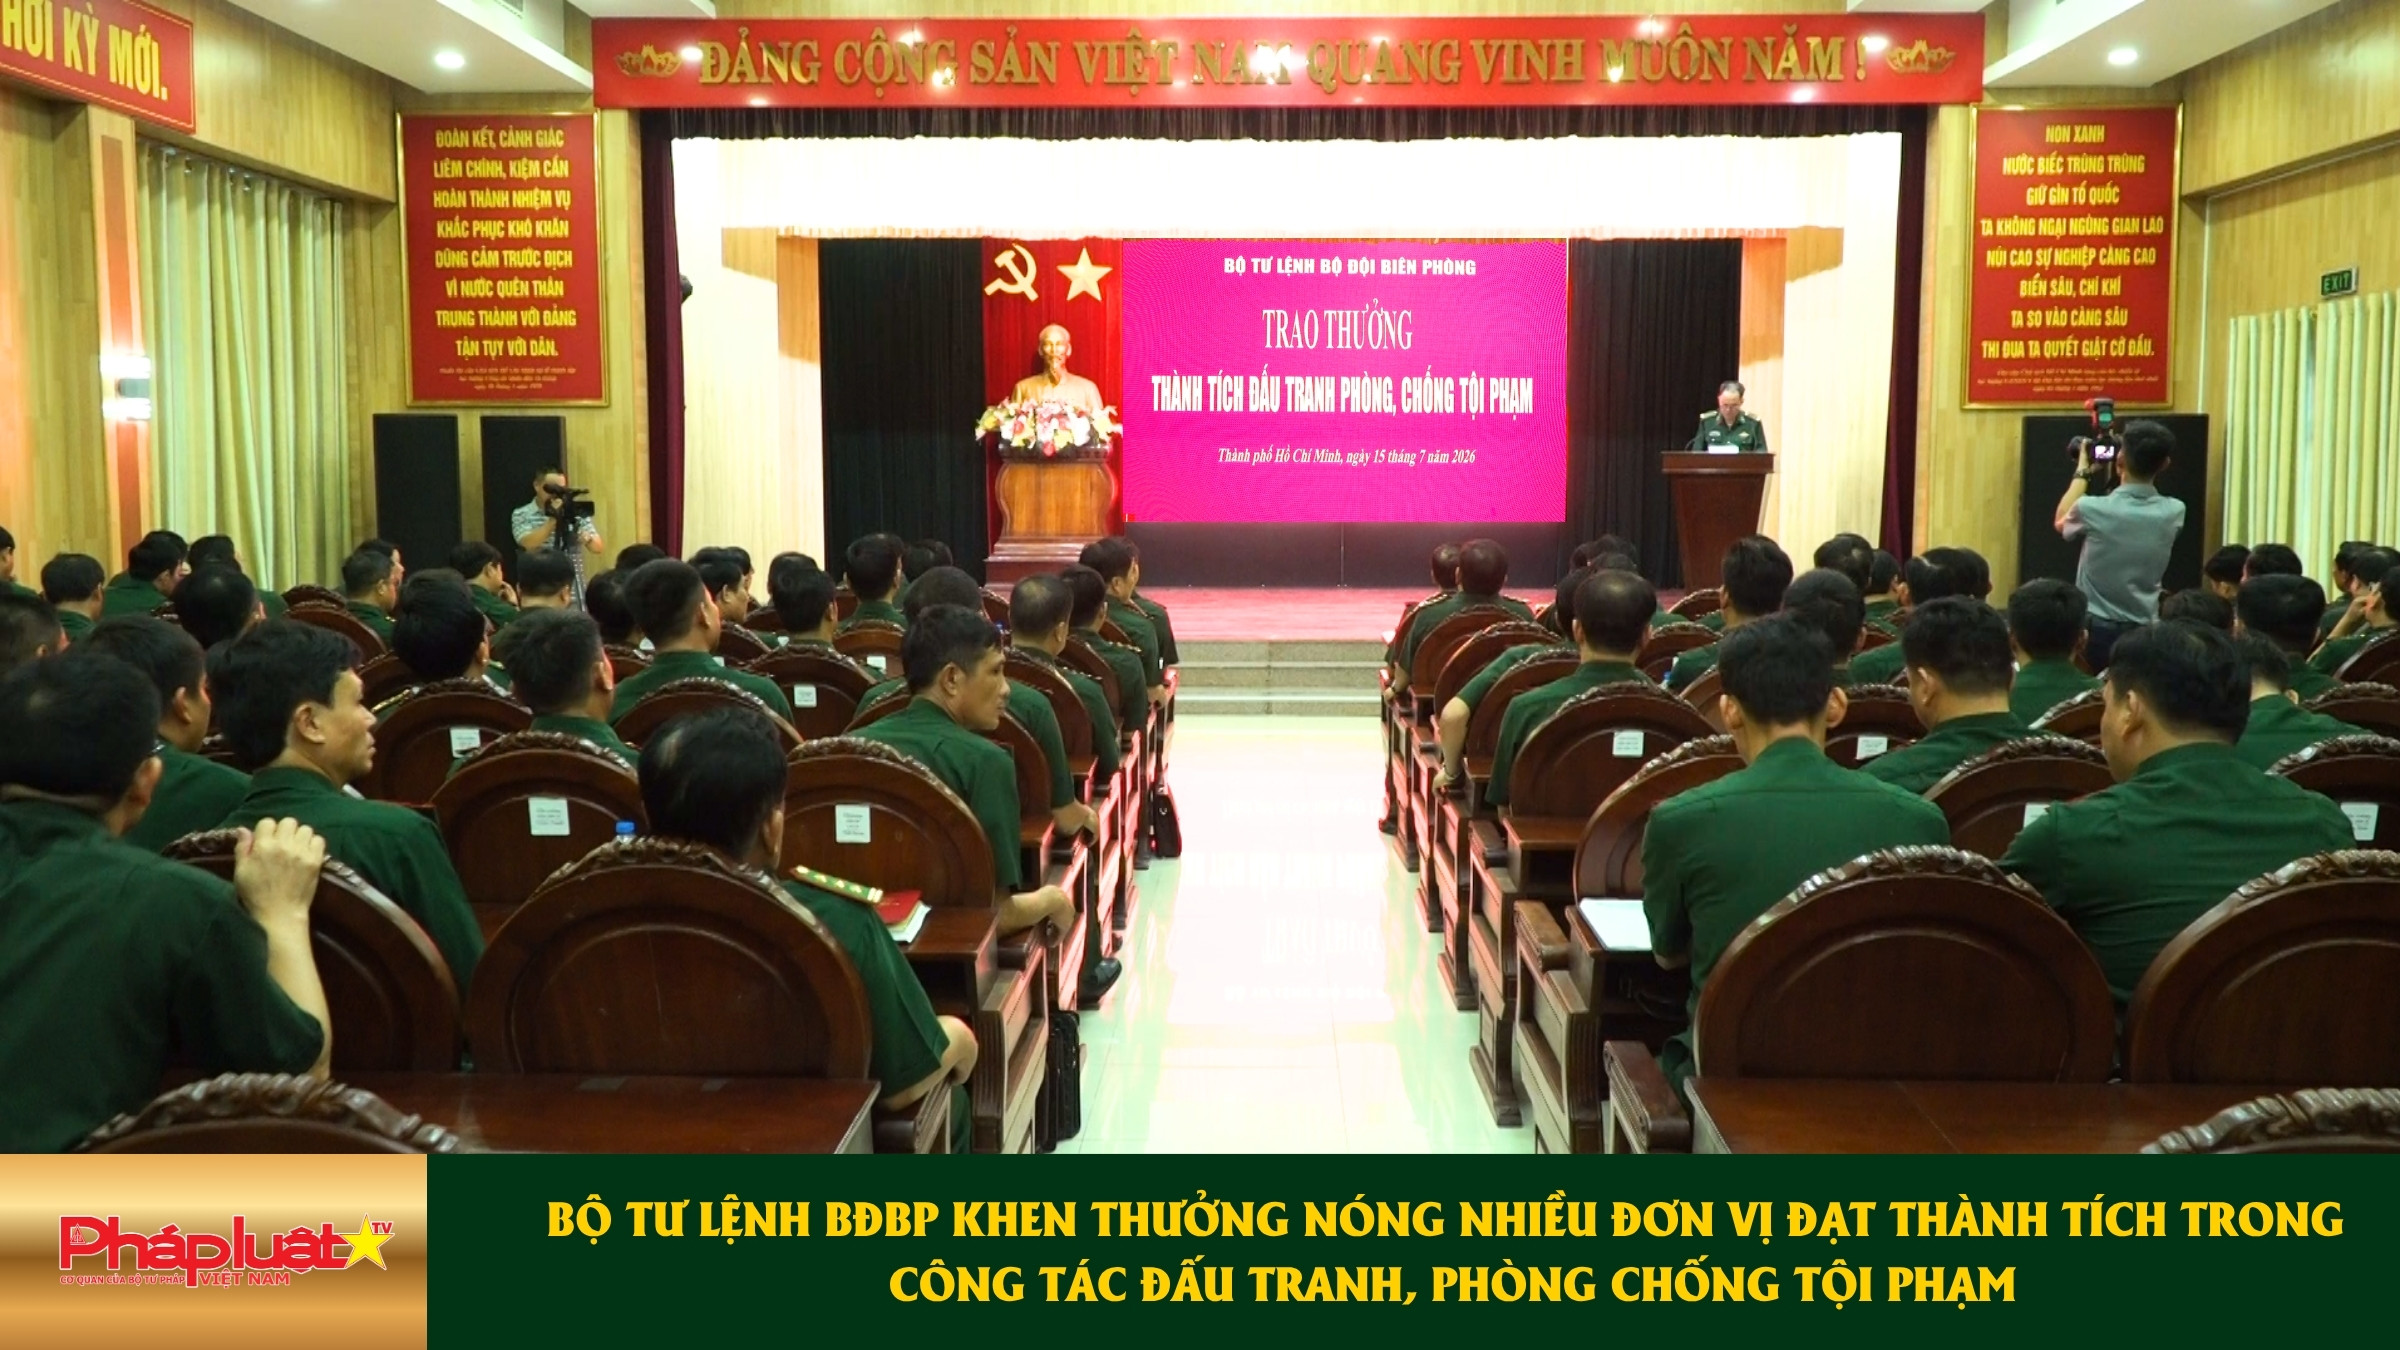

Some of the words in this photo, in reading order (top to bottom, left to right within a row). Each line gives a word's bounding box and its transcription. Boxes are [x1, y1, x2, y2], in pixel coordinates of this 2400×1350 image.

[63, 2, 99, 76] KỲ
[108, 24, 168, 101] MỚI.
[699, 27, 821, 86] ĐẢNG
[833, 27, 956, 97] CỘNG
[970, 26, 1060, 85] SẢN
[1073, 26, 1178, 96] VIỆT
[1191, 39, 1292, 85] NAM
[1306, 38, 1461, 94] QUANG
[1471, 38, 1586, 84] VINH
[1599, 23, 1733, 83] MUÔN
[1742, 24, 1845, 82] NĂM
[435, 127, 469, 148] ĐOÀN
[499, 125, 533, 148] CẢNH
[535, 125, 564, 148] GIÁC
[2045, 125, 2071, 143] NON
[2073, 125, 2105, 143] XANH
[433, 157, 463, 178] LIÊM
[509, 156, 540, 181] KIỆM
[433, 187, 467, 208] HOÀN
[469, 187, 509, 208] THÀNH
[512, 185, 552, 211] NHIỆM
[554, 190, 571, 211] VỤ
[2089, 180, 2120, 206] QUỐC
[1980, 218, 1993, 236] TA
[2112, 217, 2140, 235] GIAN
[2143, 216, 2164, 234] LAO
[471, 245, 499, 268] CẢM
[501, 245, 541, 268] TRƯỚC
[543, 250, 573, 271] ĐỊCH
[1223, 256, 1246, 276] BỘ
[1251, 257, 1272, 273] TƯ
[1277, 256, 1315, 276] LỆNH
[1320, 256, 1343, 276] BỘ
[1347, 256, 1376, 276] ĐỘI
[1381, 256, 1417, 274] BIÊN
[1422, 258, 1476, 276] PHÒNG
[1986, 246, 2007, 268] NÚI
[2009, 249, 2033, 266] CAO
[2035, 247, 2053, 270] SỰ
[2054, 245, 2096, 270] NGHIỆP
[2099, 244, 2131, 265] CÀNG
[2133, 247, 2156, 265] CAO
[2323, 272, 2350, 293] EXIT
[435, 309, 475, 327] TRUNG
[477, 305, 518, 327] THÀNH
[520, 305, 540, 326] VỚI
[542, 303, 577, 326] ĐẢNG
[1262, 309, 1319, 349] TRAO
[1324, 298, 1413, 350] THƯỞNG
[2011, 310, 2024, 328] TA
[2026, 310, 2042, 328] SO
[1982, 340, 2000, 358] THI
[2028, 340, 2041, 358] TA
[1152, 370, 1202, 412] THÀNH
[1207, 370, 1244, 412] TÍCH
[1249, 363, 1281, 413] ĐẤU
[1285, 376, 1335, 413] TRANH
[1340, 371, 1397, 416] PHÒNG,
[1401, 365, 1455, 414] CHỐNG
[1459, 370, 1485, 420] TỘI
[1489, 377, 1533, 420] PHẠM
[1218, 448, 1250, 462] Thành
[1252, 444, 1273, 466] phố
[1275, 444, 1291, 463] Hồ
[1292, 447, 1312, 463] Chí
[1313, 448, 1343, 465] Minh,
[1346, 449, 1371, 467] ngày
[1373, 449, 1385, 463] 15
[1387, 448, 1416, 466] tháng
[1419, 449, 1426, 463] 7
[1427, 448, 1450, 463] năm
[1451, 449, 1476, 463] 2026
